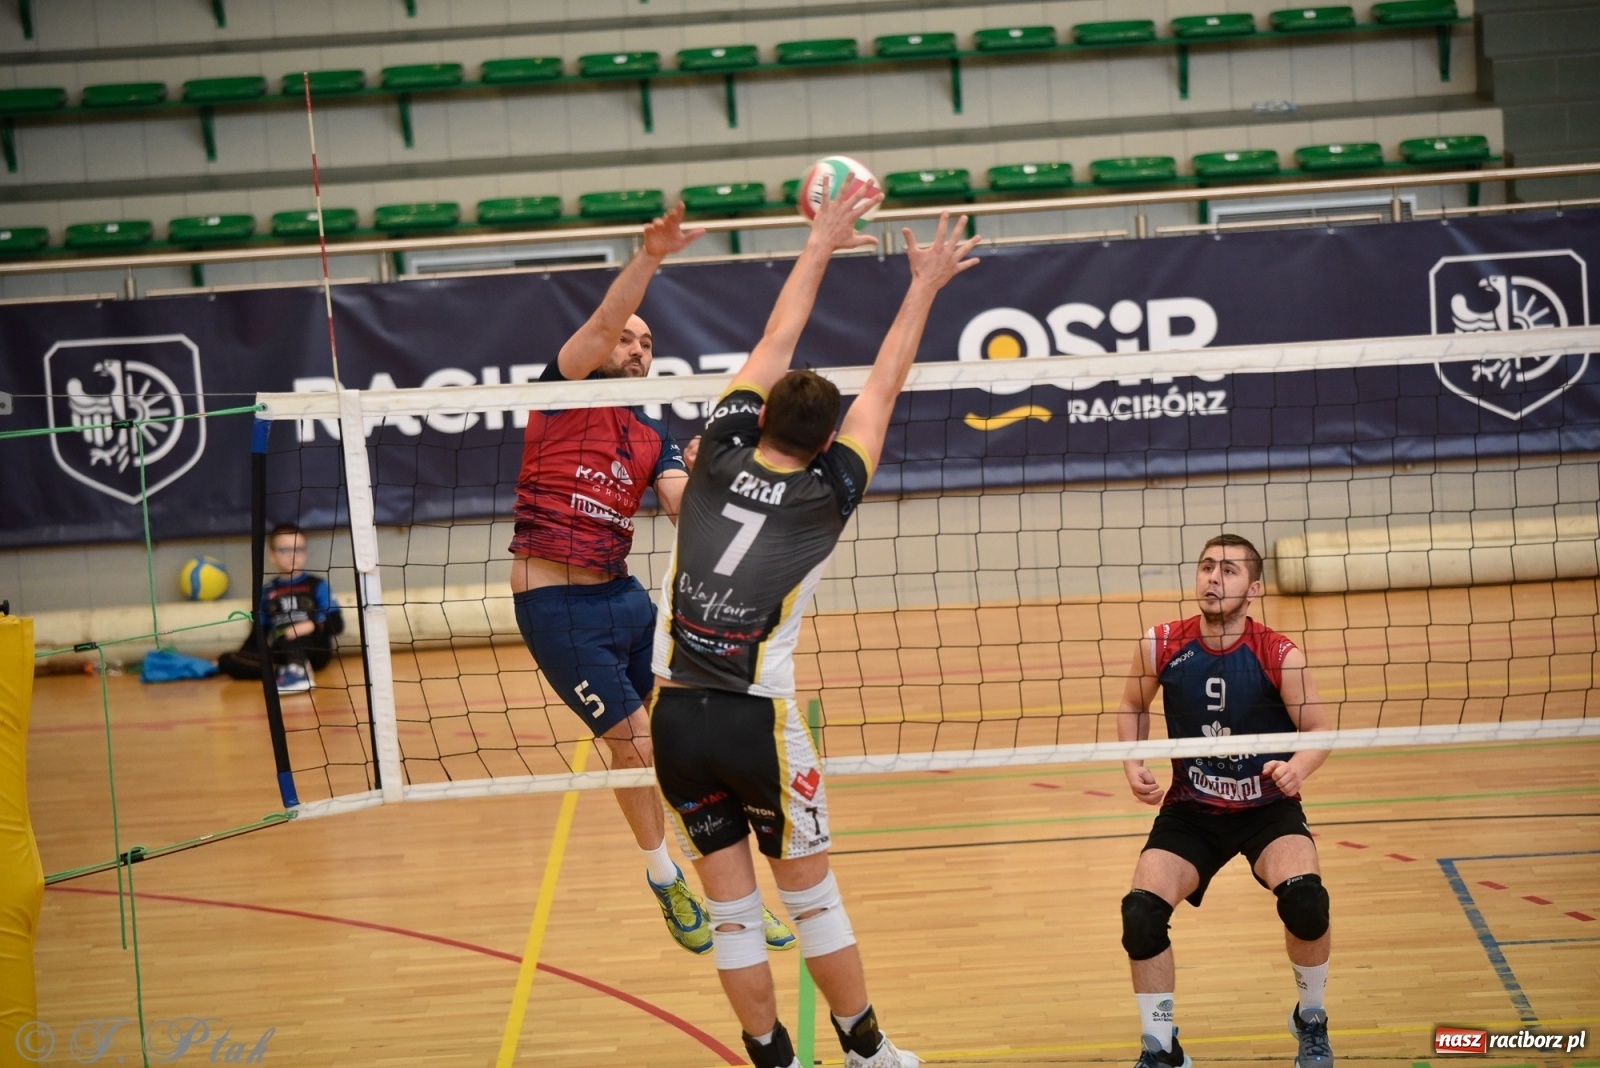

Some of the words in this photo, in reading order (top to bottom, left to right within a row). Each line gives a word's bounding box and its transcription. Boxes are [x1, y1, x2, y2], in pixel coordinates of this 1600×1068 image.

[1067, 385, 1228, 423] RACIBÓRZ
[729, 470, 786, 505] ENTER
[713, 502, 767, 577] 7
[574, 680, 605, 719] 5
[1206, 677, 1226, 712] 9
[1195, 758, 1243, 772] GROUP
[805, 806, 819, 836] 7
